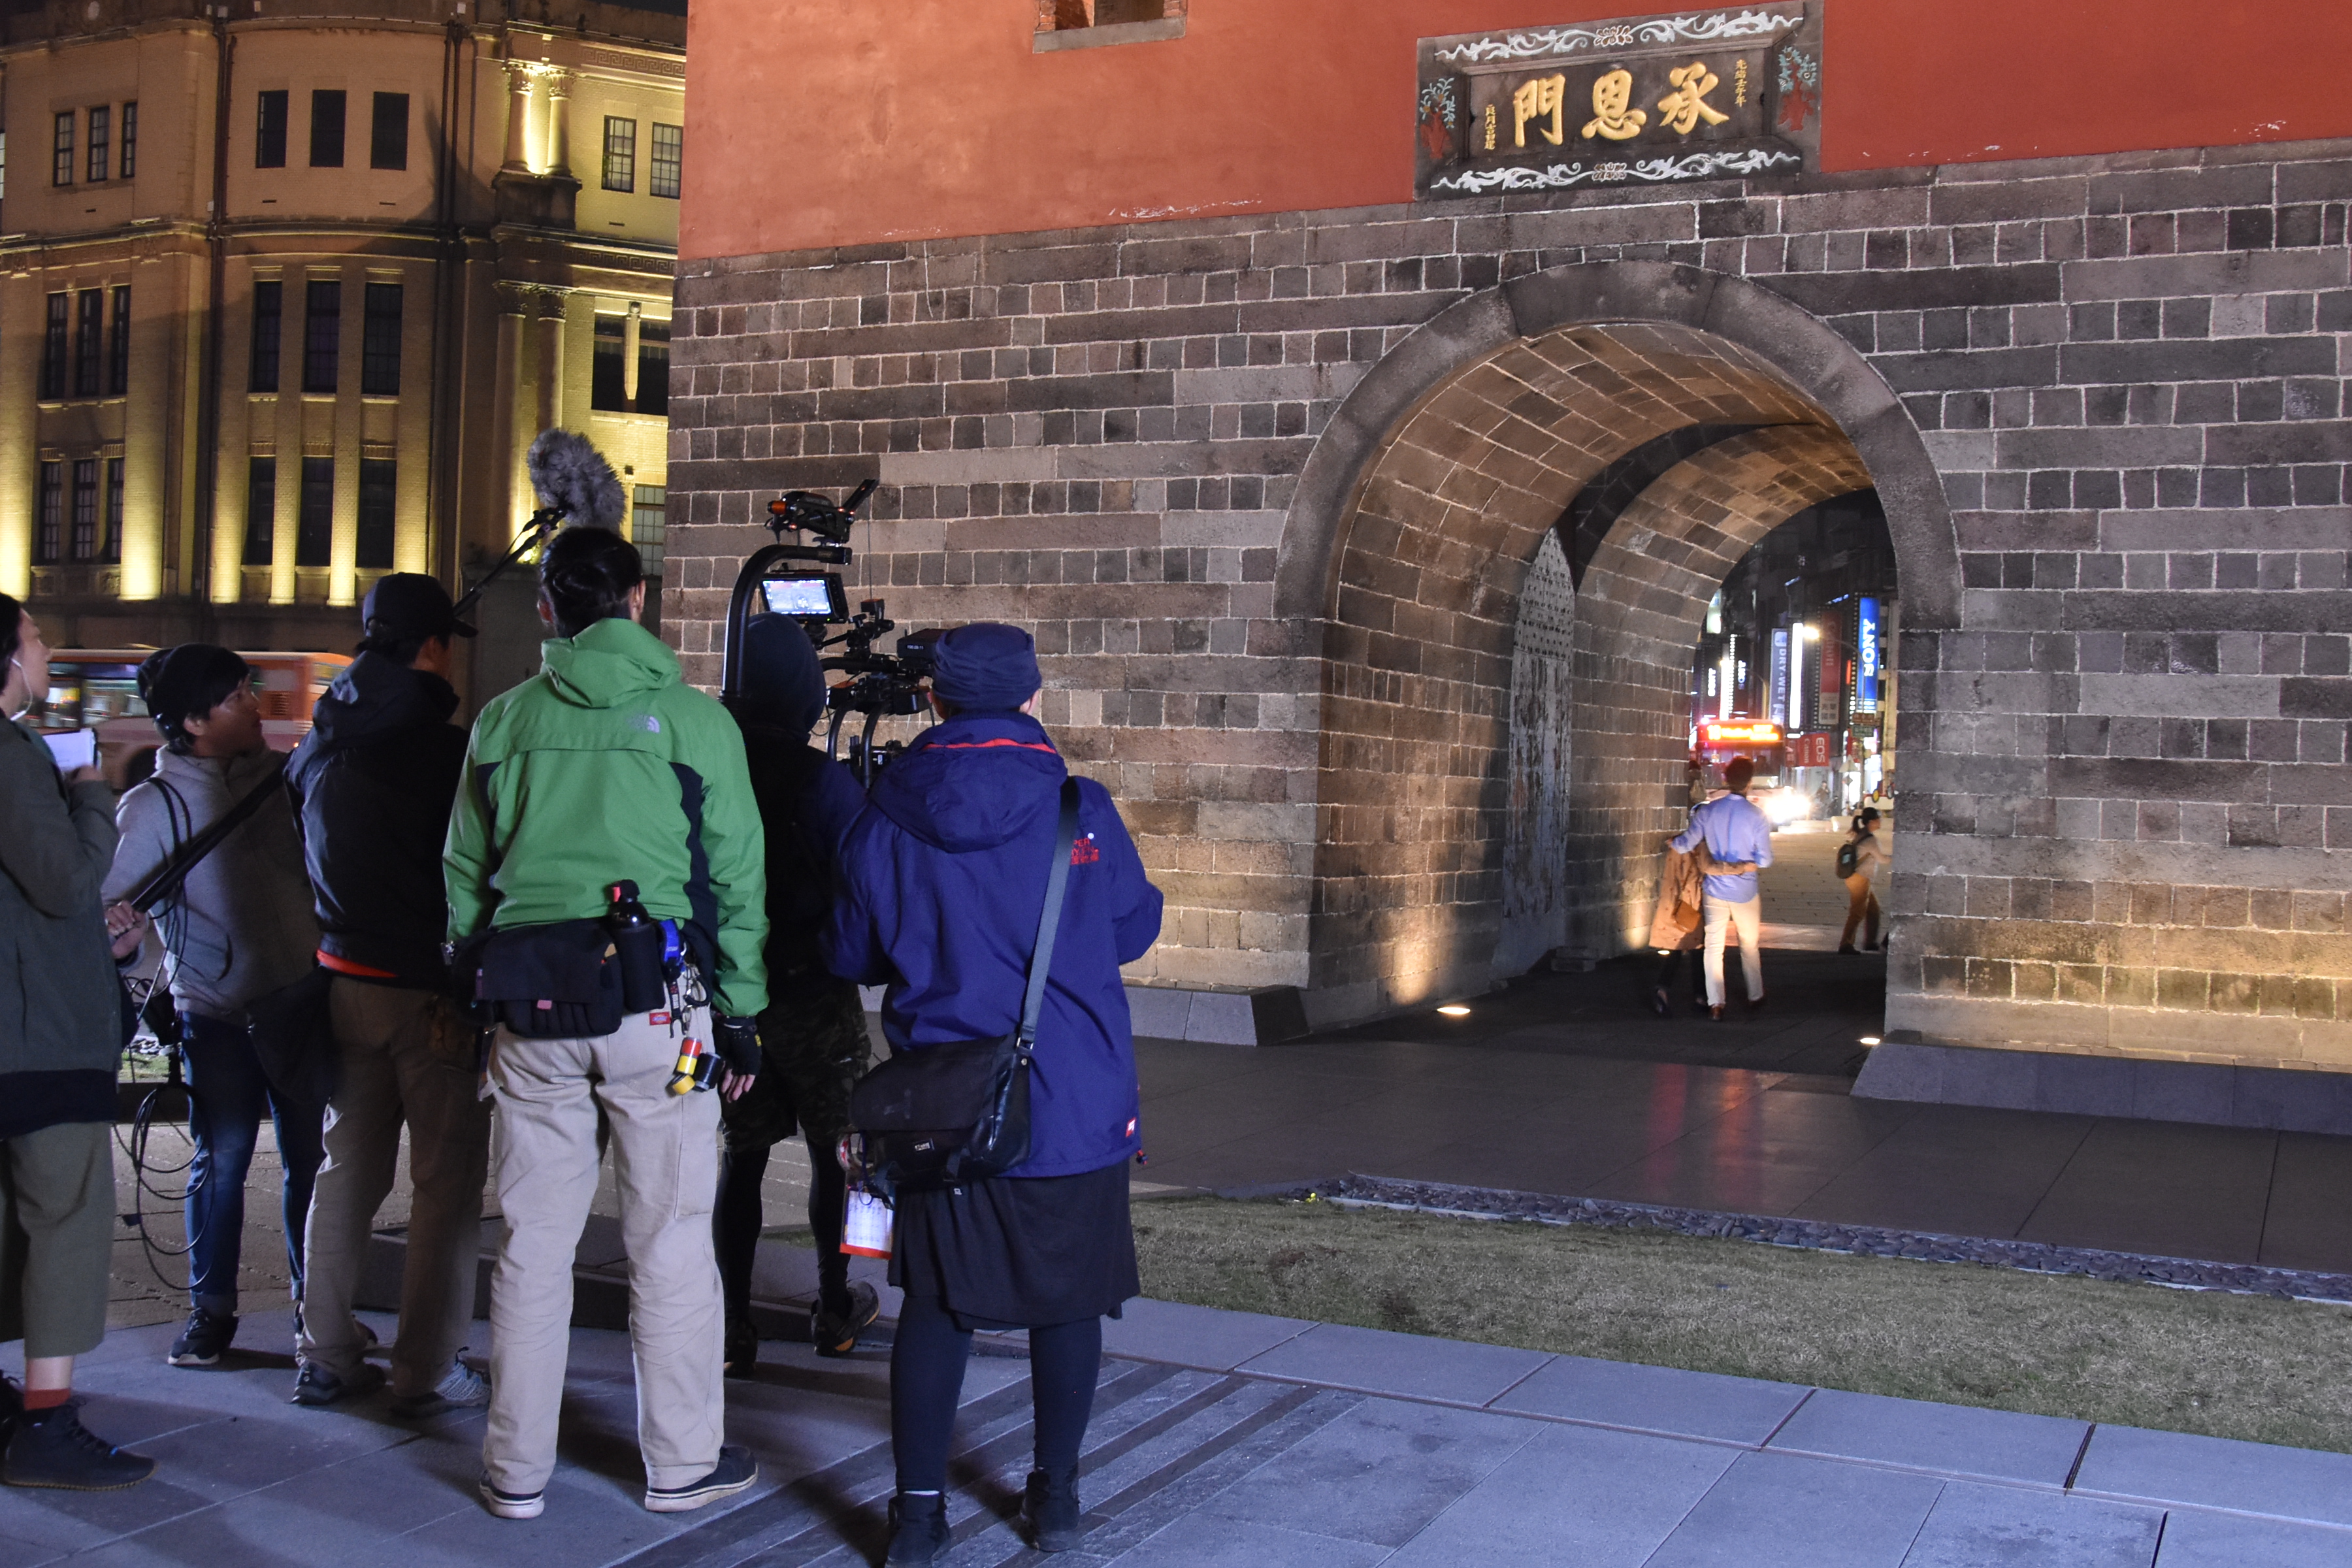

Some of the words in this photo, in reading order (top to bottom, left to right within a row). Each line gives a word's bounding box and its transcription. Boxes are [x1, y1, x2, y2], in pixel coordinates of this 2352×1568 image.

[1778, 648, 1787, 702] DRY-WET
[1862, 619, 1876, 677] SONY
[1816, 737, 1825, 762] EOS
